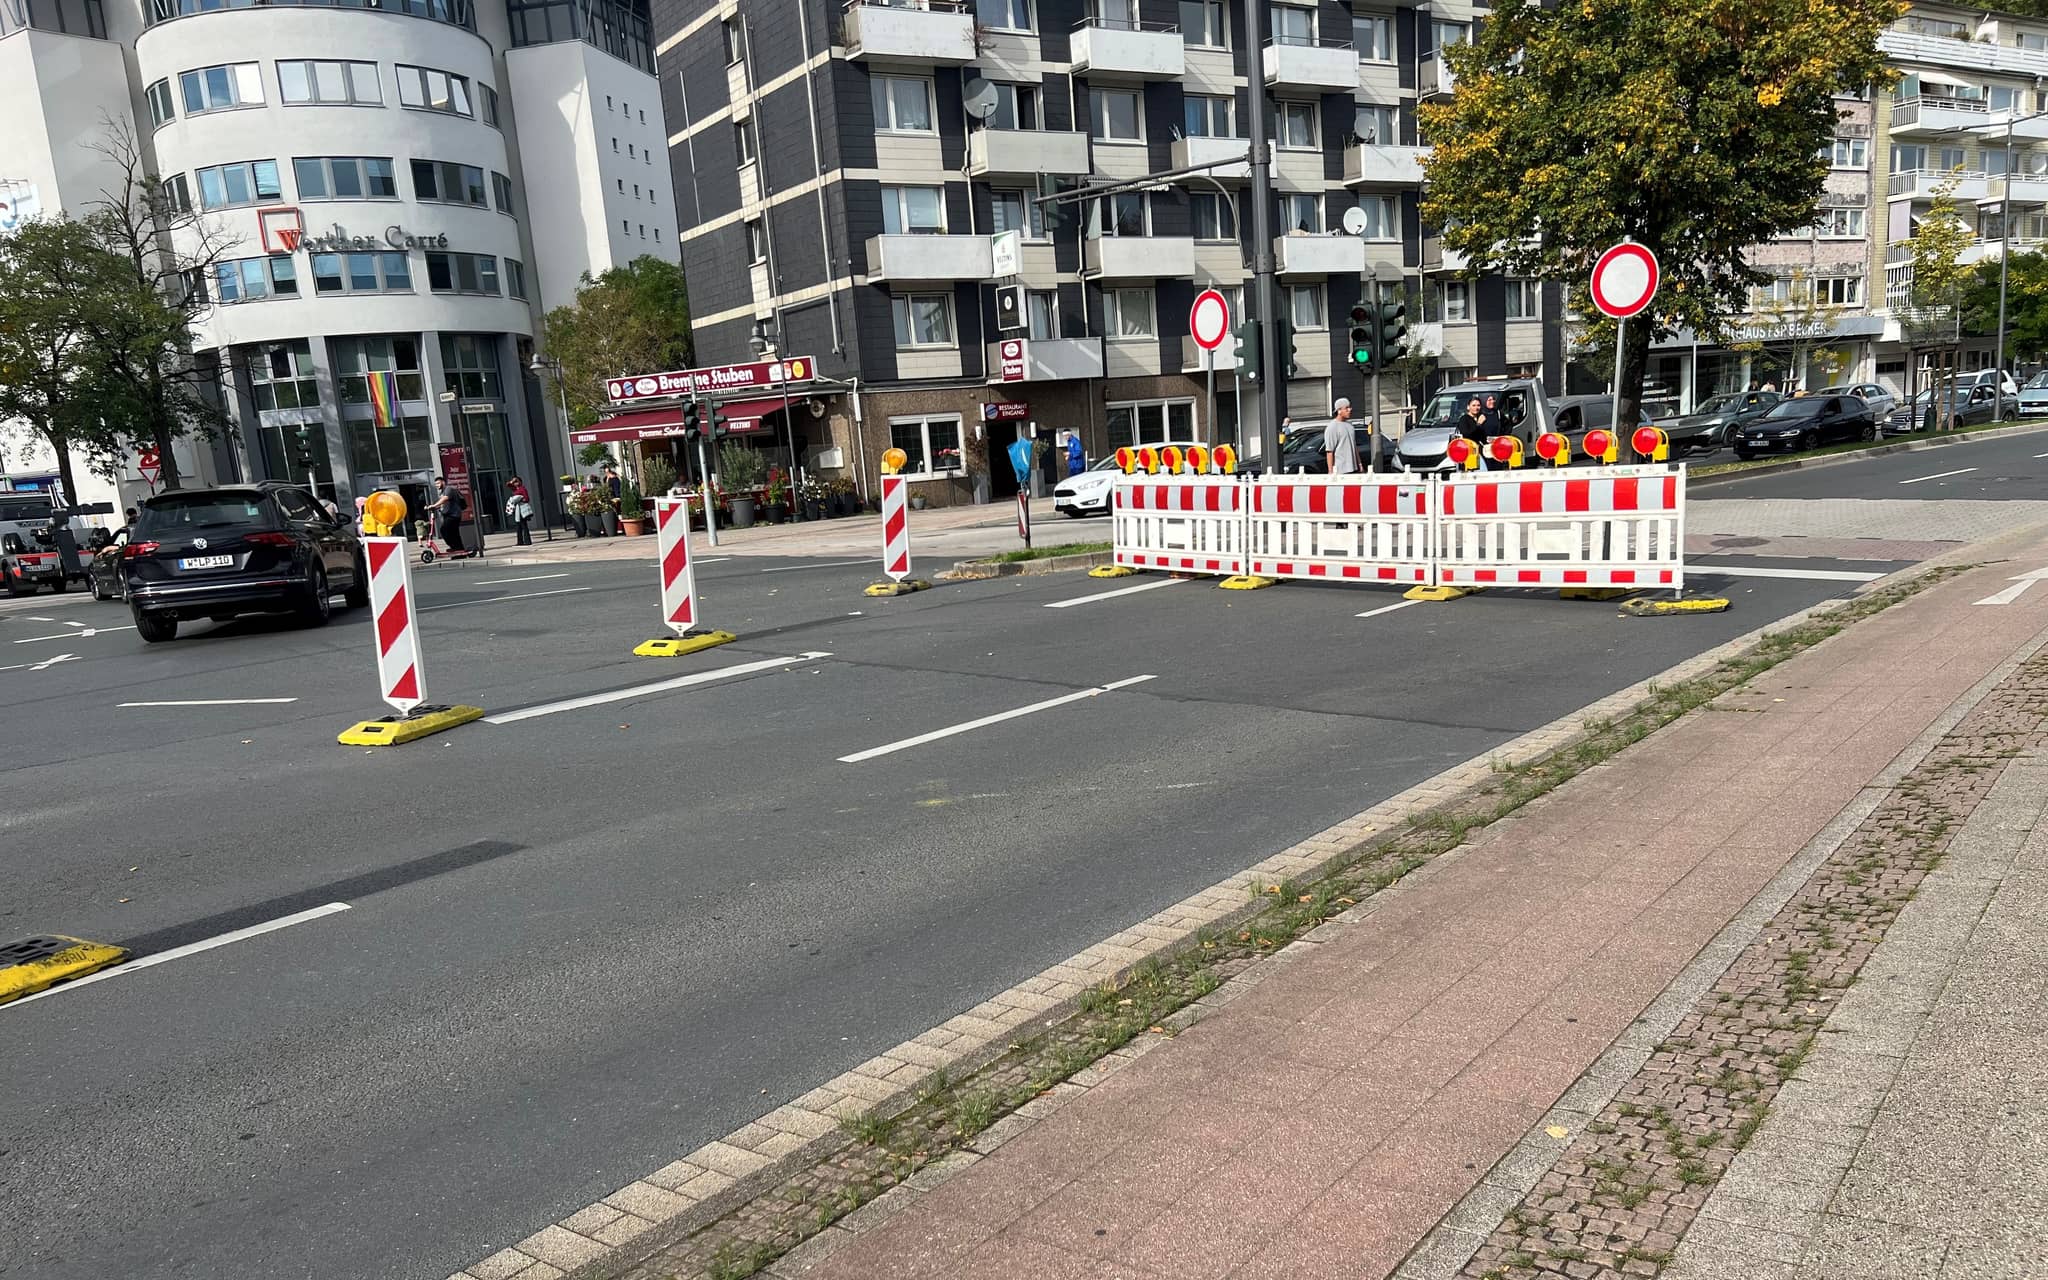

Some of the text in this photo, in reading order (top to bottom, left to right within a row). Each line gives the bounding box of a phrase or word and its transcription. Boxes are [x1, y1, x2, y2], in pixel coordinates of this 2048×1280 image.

[384, 224, 450, 249] Carré
[711, 368, 754, 384] Stuben
[999, 403, 1028, 411] RESTAURANT
